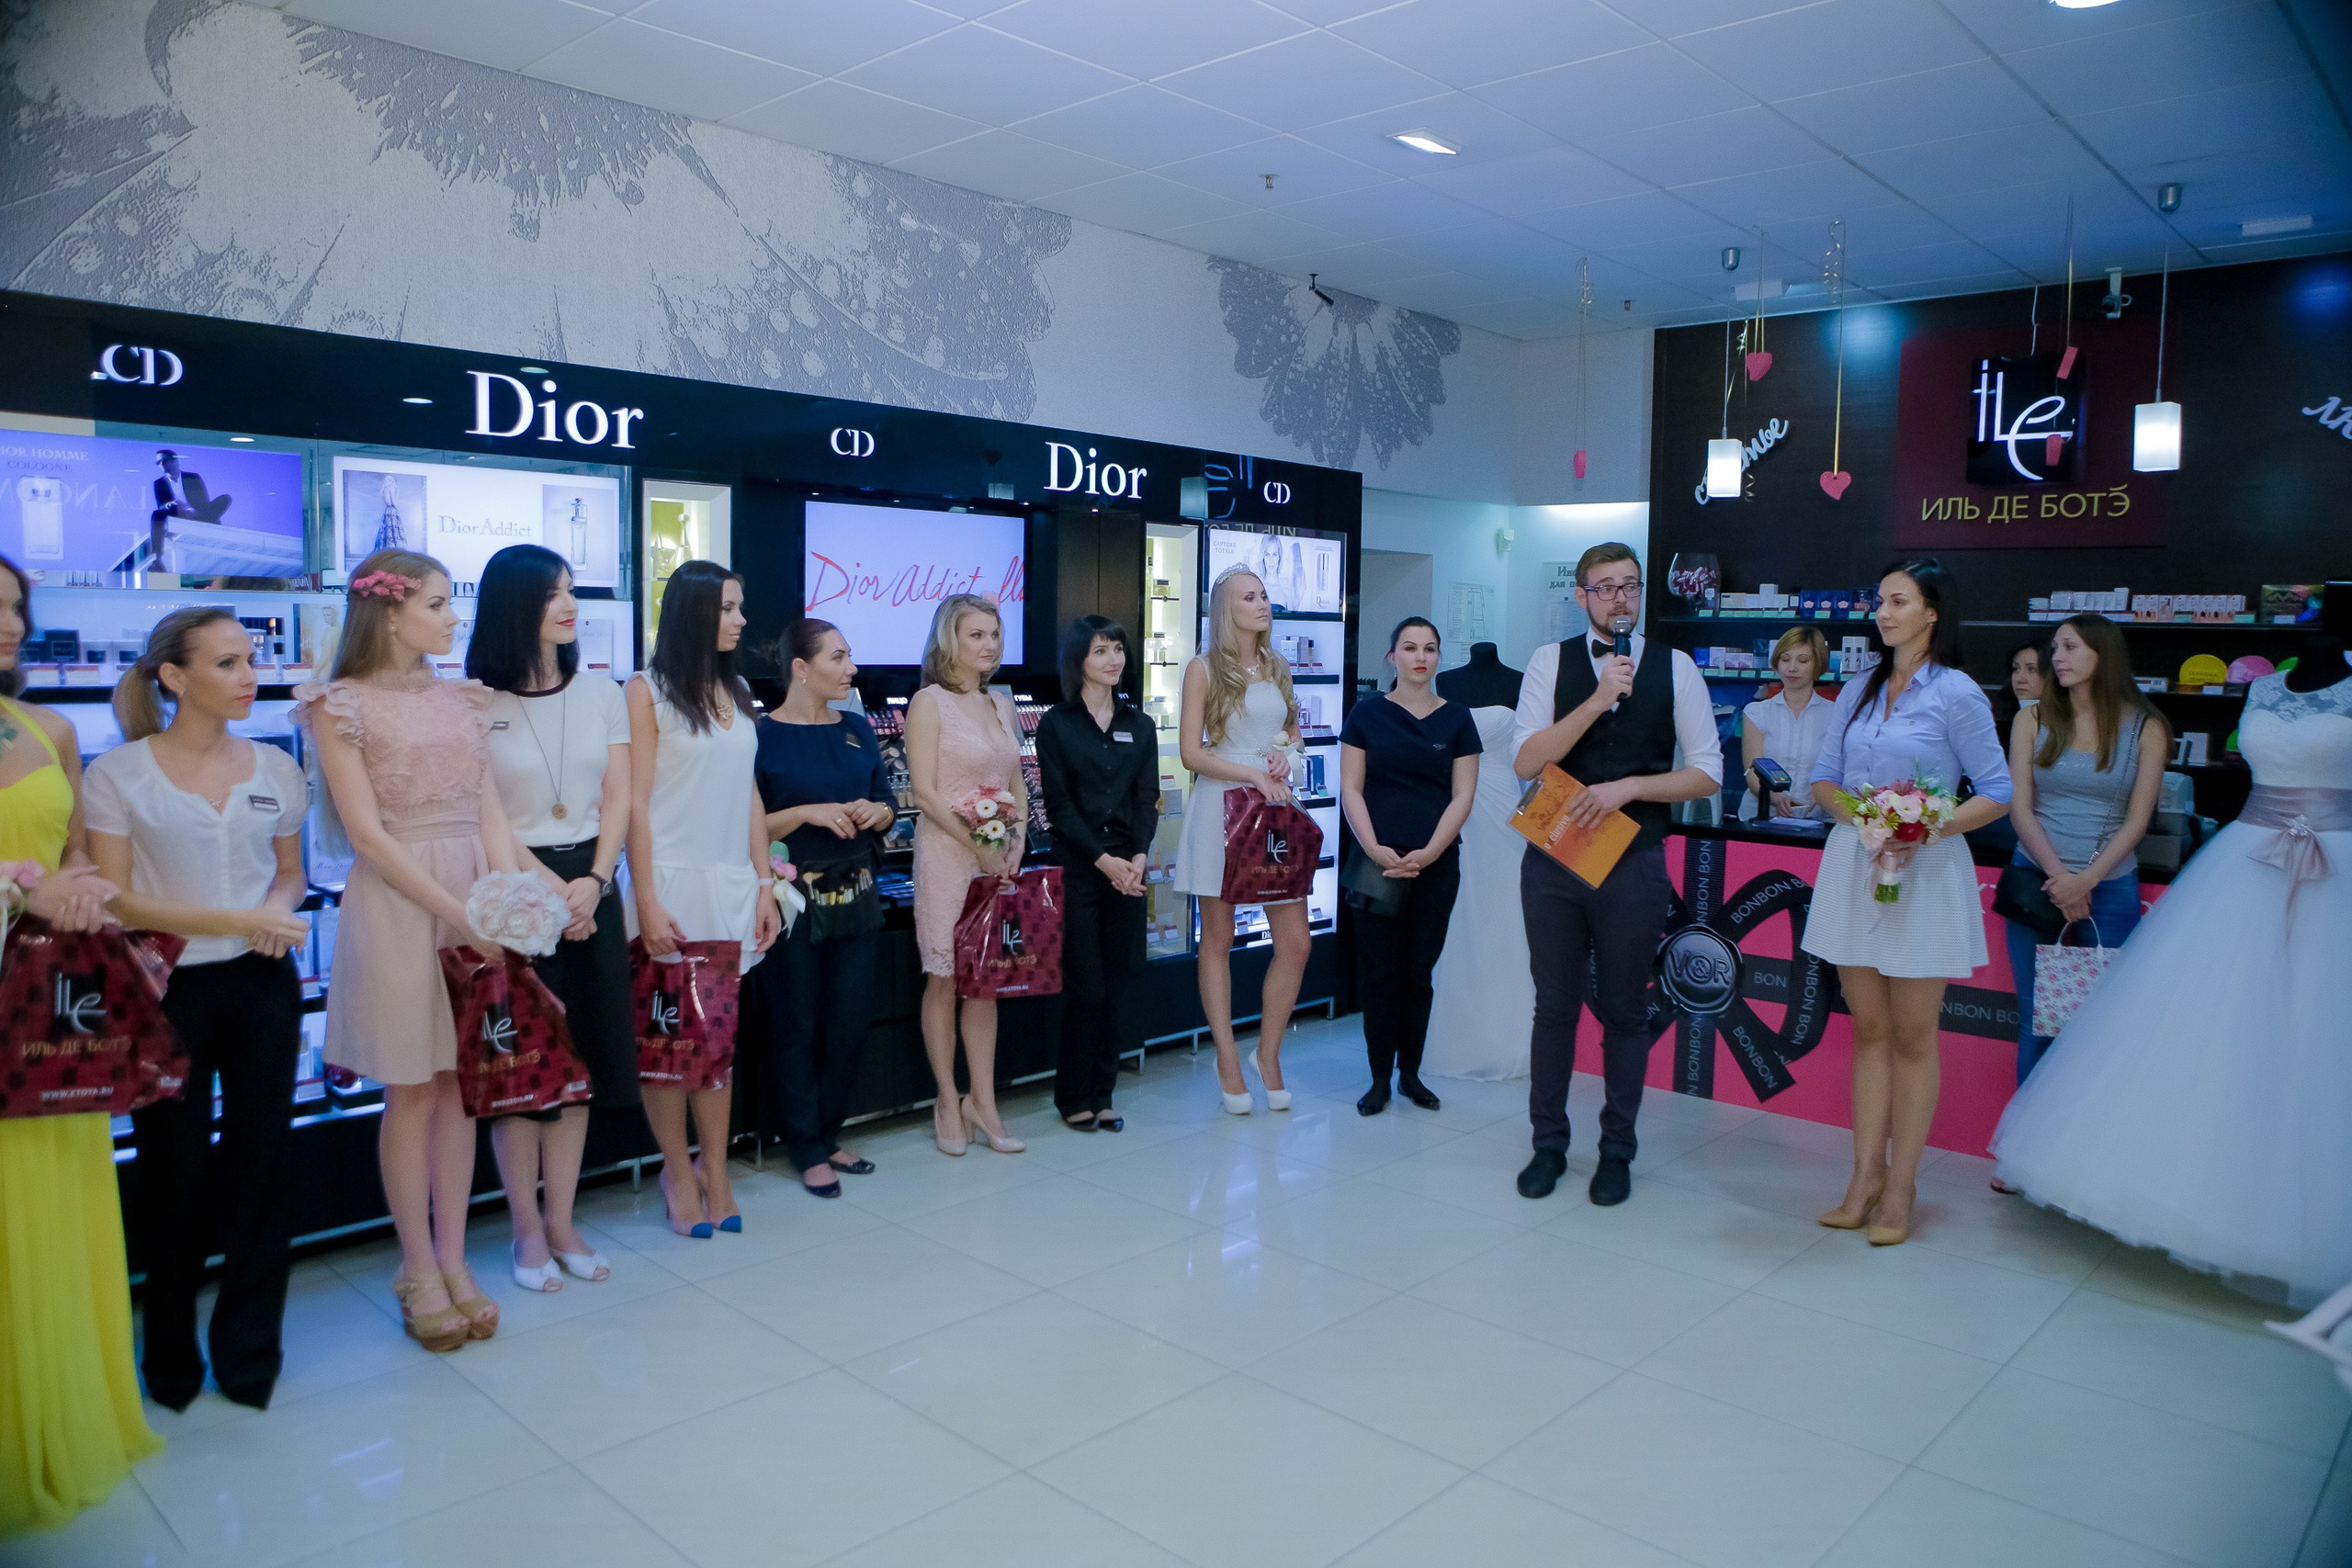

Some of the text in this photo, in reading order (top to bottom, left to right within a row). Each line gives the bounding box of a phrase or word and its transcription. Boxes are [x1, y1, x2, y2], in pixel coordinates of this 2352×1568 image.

[464, 370, 644, 449] Dior
[0, 446, 89, 461] IOR HOMME
[7, 460, 73, 473] COLOGNE
[1043, 441, 1148, 499] Dior
[439, 514, 532, 537] Dior Addict
[1922, 497, 1981, 521] ИЛЬ
[1987, 496, 2030, 525] ДЕ
[1213, 540, 1237, 548] CAPTURE
[805, 551, 900, 611] Dior
[1700, 840, 1712, 873] BON
[1730, 881, 1792, 924] BONBON
[1754, 971, 1787, 987] BON
[1792, 1013, 1811, 1044] BON
[21, 1041, 56, 1058] ИЛЬ
[60, 1038, 81, 1057] ДЕ
[1687, 1017, 1702, 1081] BONBON
[1733, 1025, 1778, 1089] BONBON
